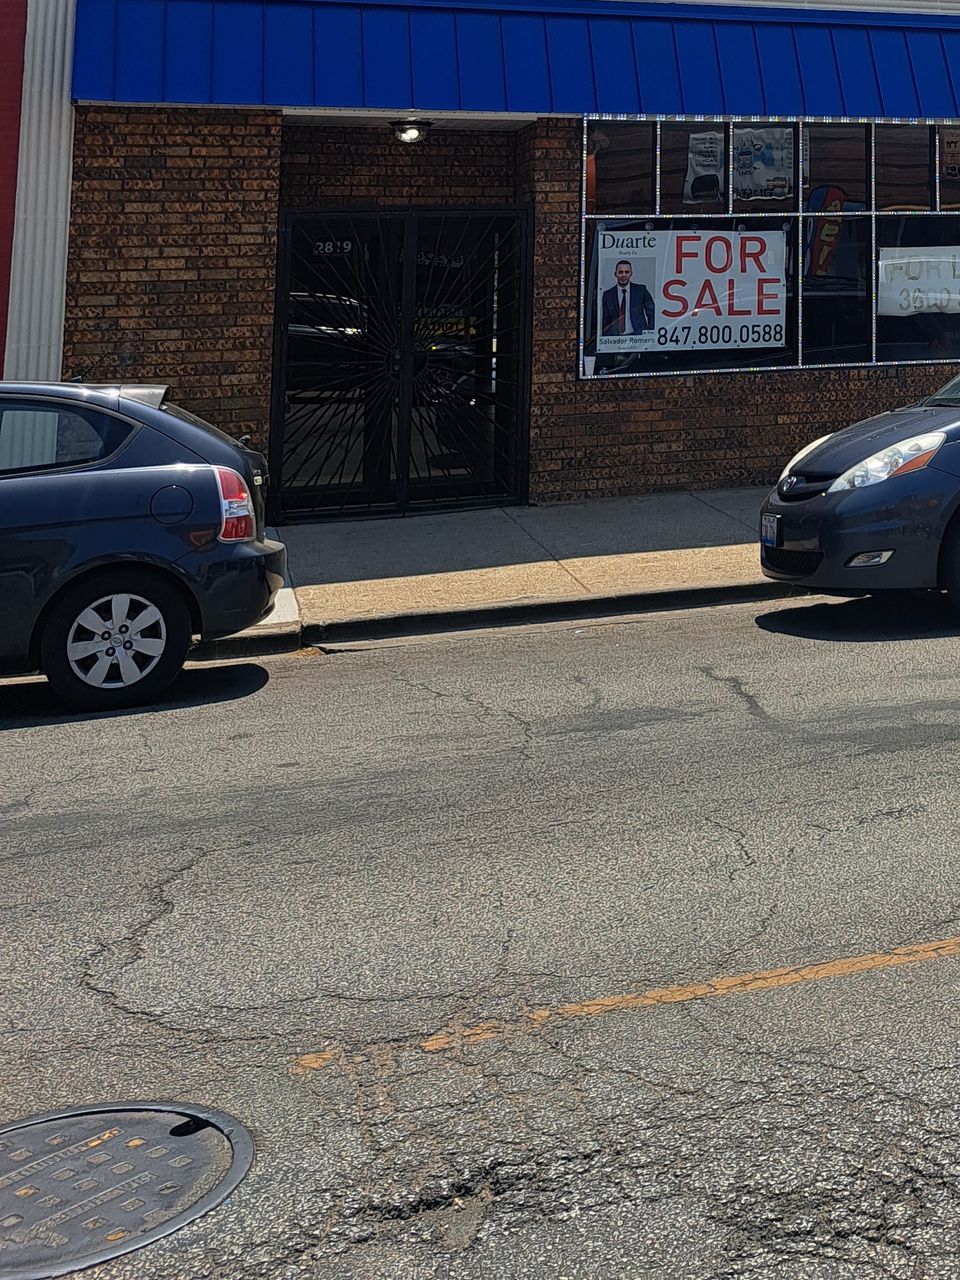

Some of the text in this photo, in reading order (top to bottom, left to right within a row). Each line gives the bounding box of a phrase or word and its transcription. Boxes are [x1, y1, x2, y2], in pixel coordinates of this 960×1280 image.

[315, 240, 352, 254] 2819
[600, 233, 657, 249] Duarte
[675, 235, 768, 274] FOR
[661, 278, 782, 318] SALE
[599, 337, 628, 345] Salvador
[657, 324, 783, 346] 847.800.0588
